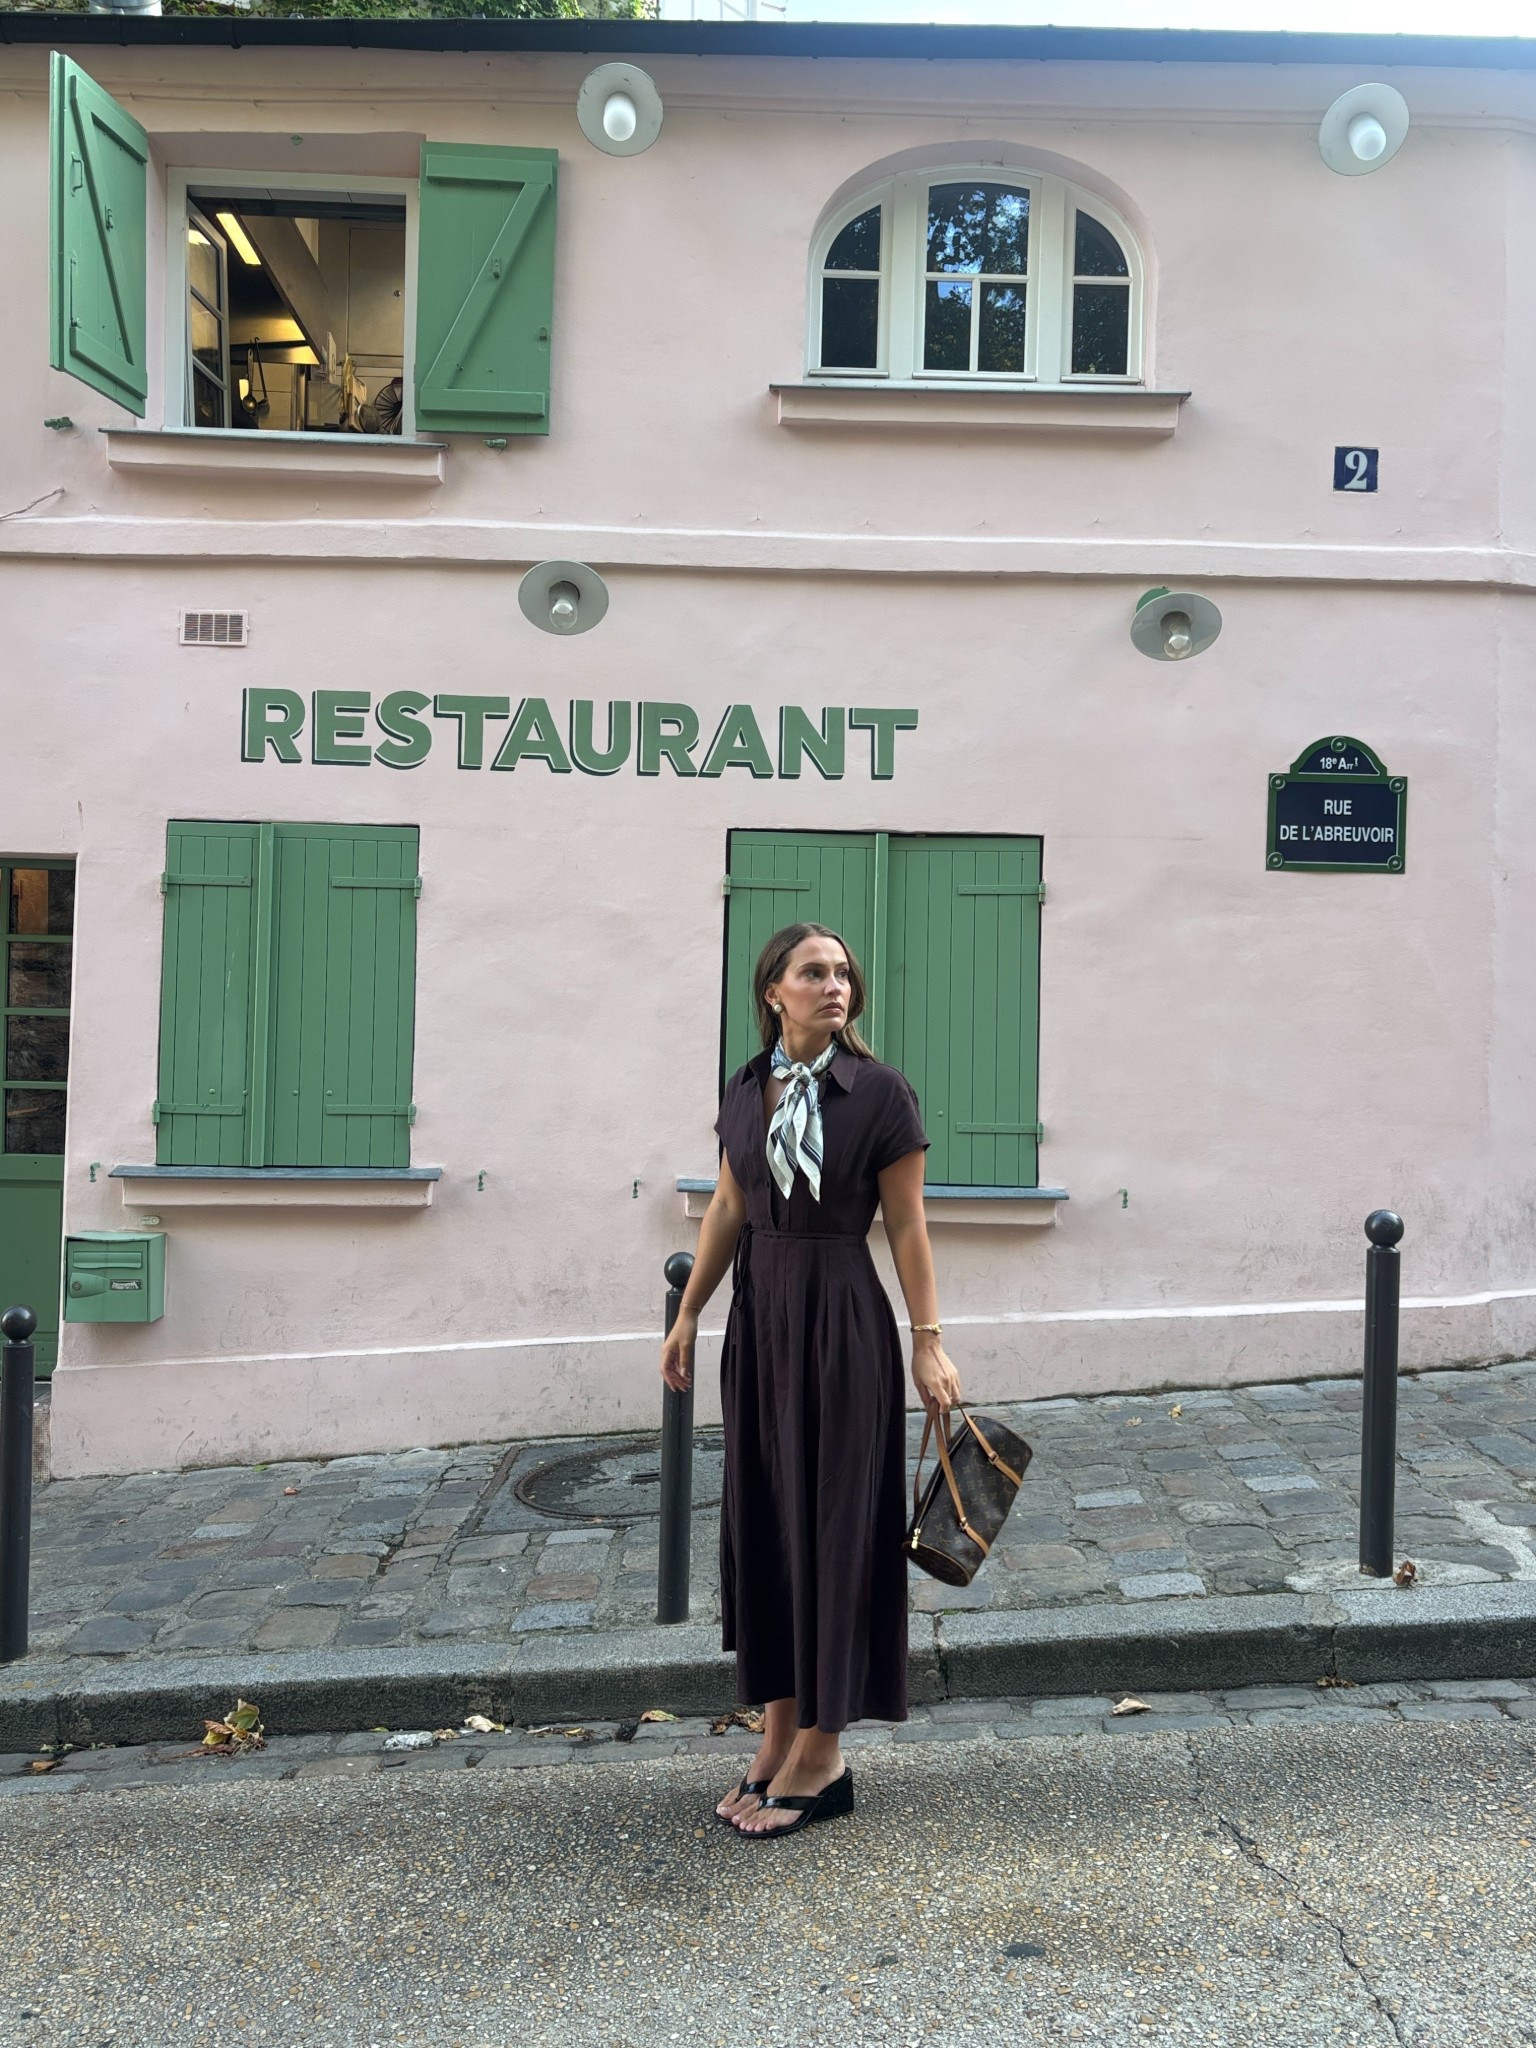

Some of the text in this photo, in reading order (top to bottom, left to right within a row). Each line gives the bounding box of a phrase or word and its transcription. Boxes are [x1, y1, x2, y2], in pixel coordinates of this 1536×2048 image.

[1344, 450, 1368, 490] 2
[241, 687, 919, 780] RESTAURANT
[1323, 799, 1352, 816] RUE
[1279, 825, 1299, 841] DE
